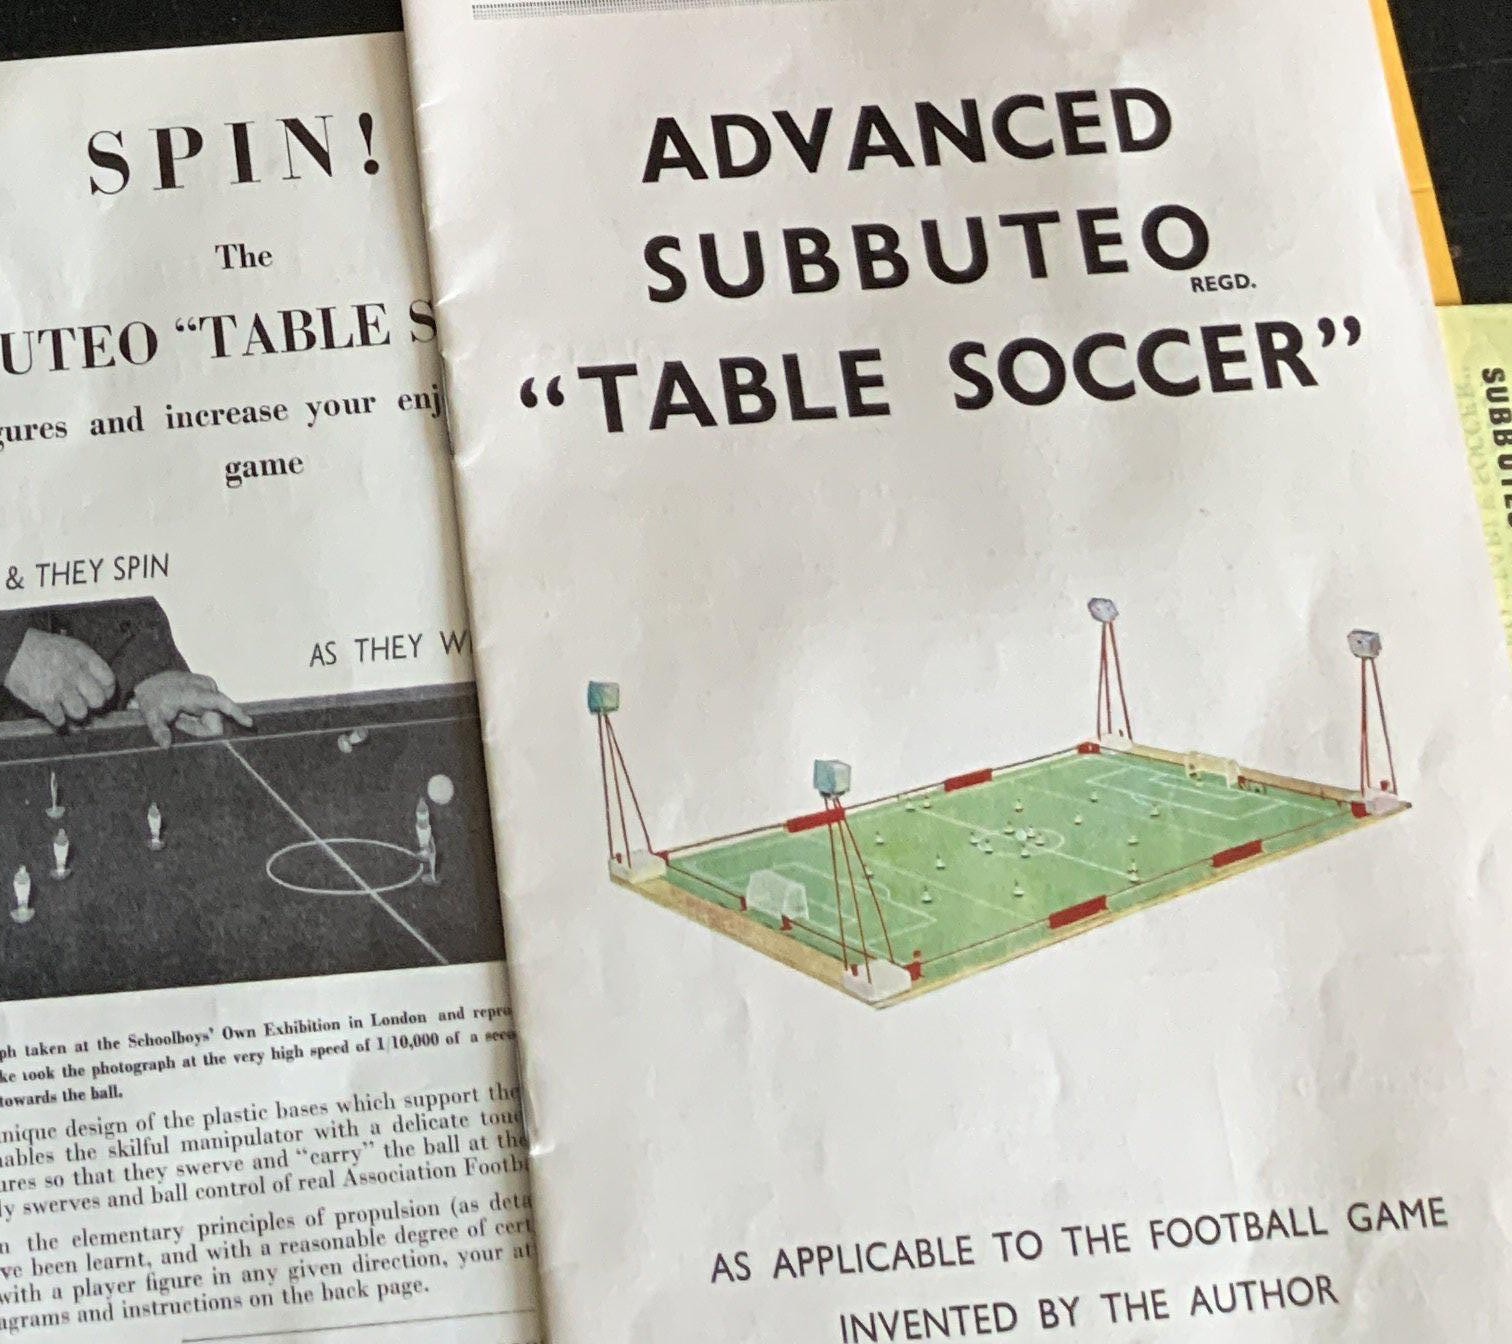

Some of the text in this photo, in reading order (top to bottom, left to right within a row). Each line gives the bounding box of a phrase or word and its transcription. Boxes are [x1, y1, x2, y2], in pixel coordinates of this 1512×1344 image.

[87, 112, 380, 196] SPIN!
[642, 86, 1173, 184] ADVANCED
[215, 242, 273, 271] The
[643, 204, 1257, 302] SUBBUTEO REGD.
[176, 303, 390, 358] “TABLE
[518, 347, 890, 433] “TABLE
[952, 315, 1362, 410] SOCCER”
[90, 405, 144, 436] and
[166, 404, 288, 429] increase
[305, 397, 376, 428] your
[0, 1090, 57, 1108] towards
[62, 1088, 86, 1102] the
[90, 1084, 123, 1101] ball.
[711, 1196, 1448, 1283] AS APPLICABLE TO THE FOOTBALL GAME
[78, 1302, 113, 1323] and
[123, 1296, 242, 1318] instructions
[250, 1294, 273, 1307] on
[282, 1285, 313, 1304] the
[321, 1279, 369, 1301] back
[377, 1280, 429, 1302] page.
[840, 1274, 1339, 1344] INVENTED BY THE AUTHOR
